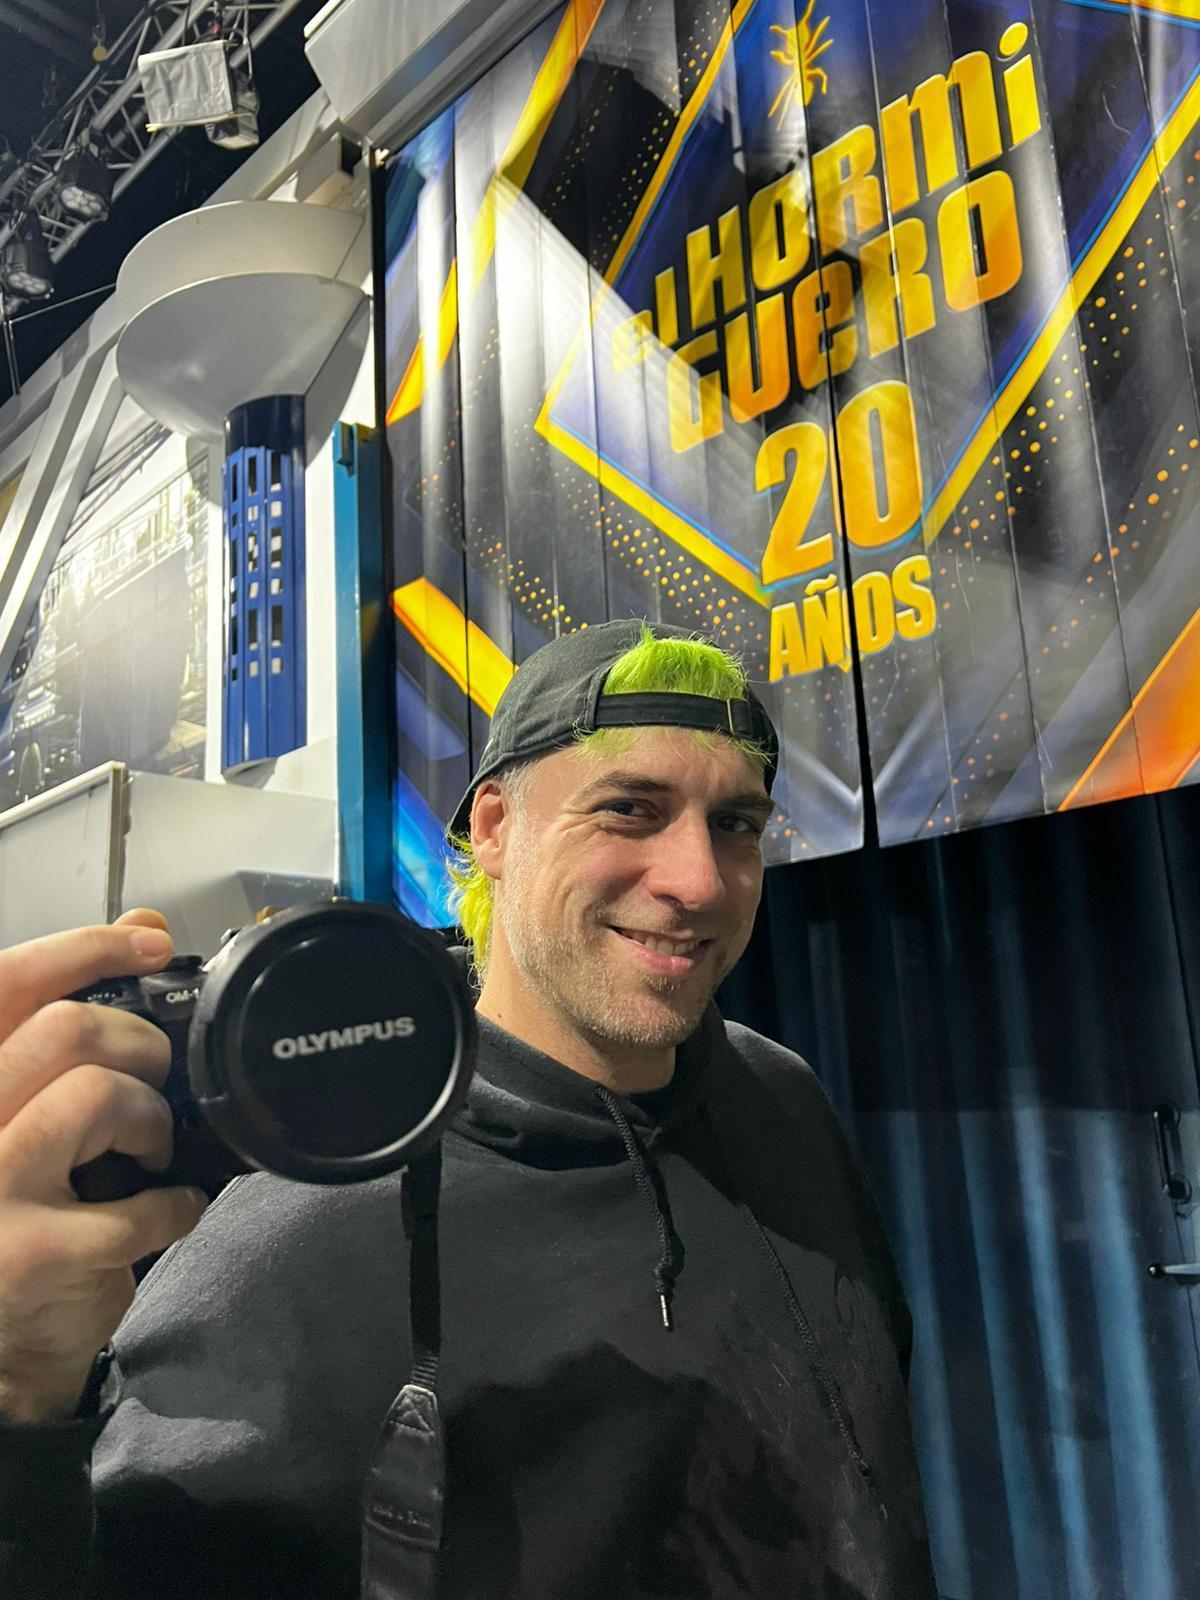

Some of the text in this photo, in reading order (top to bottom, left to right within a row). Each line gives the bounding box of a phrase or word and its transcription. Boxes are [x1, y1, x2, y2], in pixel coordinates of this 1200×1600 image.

[755, 380, 925, 584] 20
[768, 555, 937, 683] AÑOS
[272, 1016, 416, 1060] OLYMPUS
